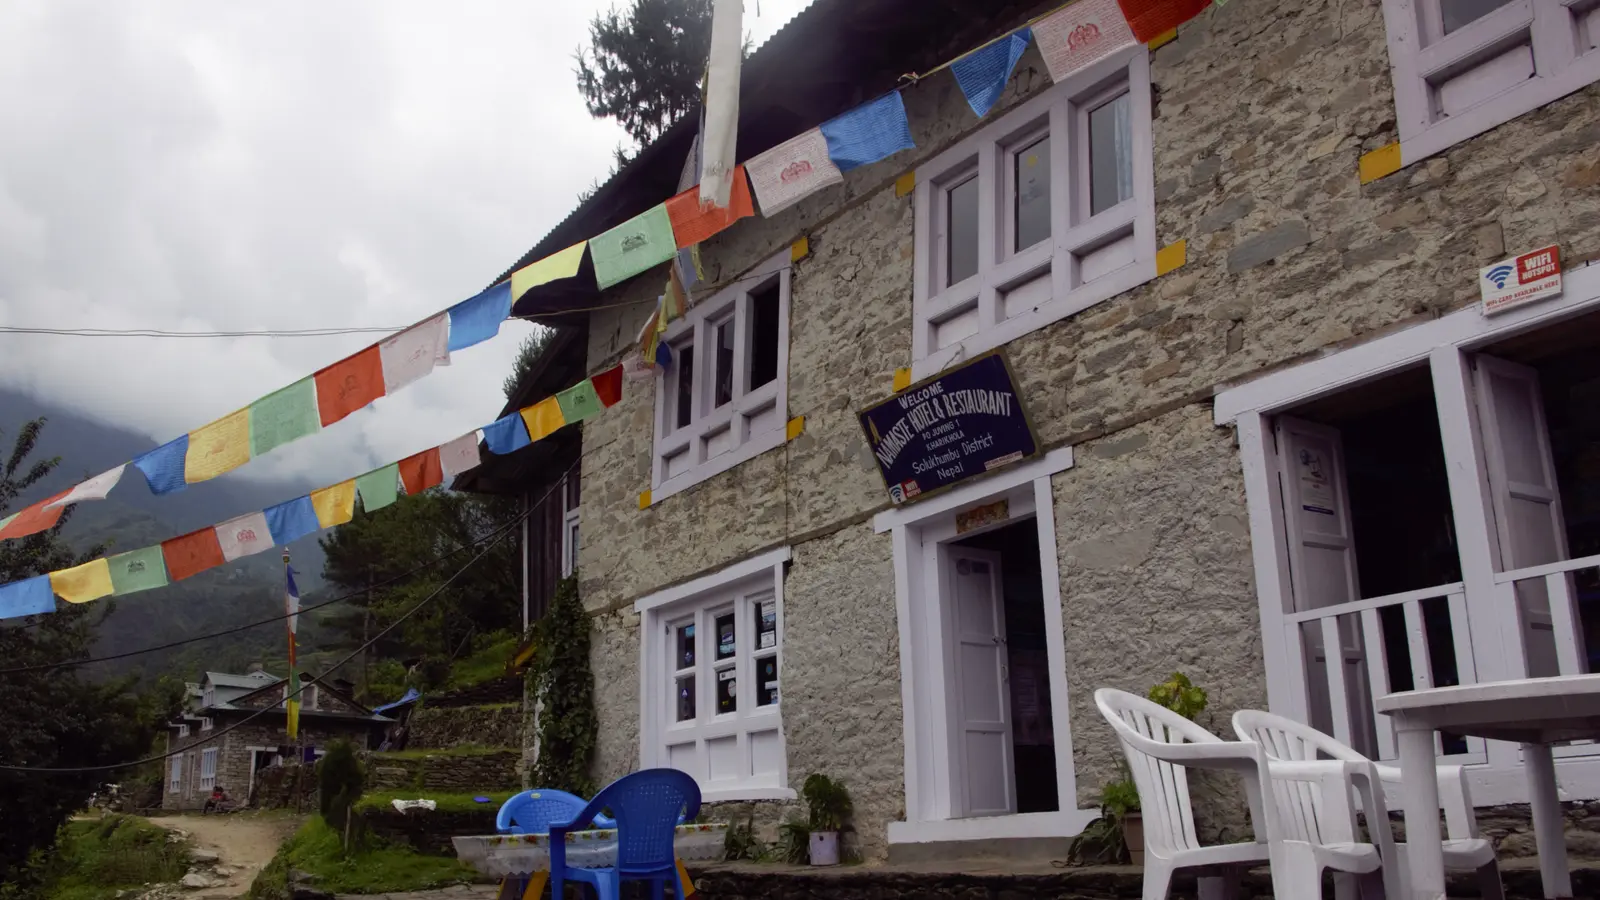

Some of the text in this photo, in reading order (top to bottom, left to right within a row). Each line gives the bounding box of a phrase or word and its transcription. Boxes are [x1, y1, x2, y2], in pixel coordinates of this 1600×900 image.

[1522, 263, 1555, 280] HOTSPOT
[1524, 252, 1552, 270] WIFI
[898, 381, 944, 409] WELCOME
[876, 389, 1012, 469] NAMASTE HOTEL & RESTAURANT
[926, 430, 965, 451] KHARIKHOLA
[912, 447, 961, 475] Solukhumbu
[962, 433, 994, 456] District
[937, 462, 964, 480] Nepal
